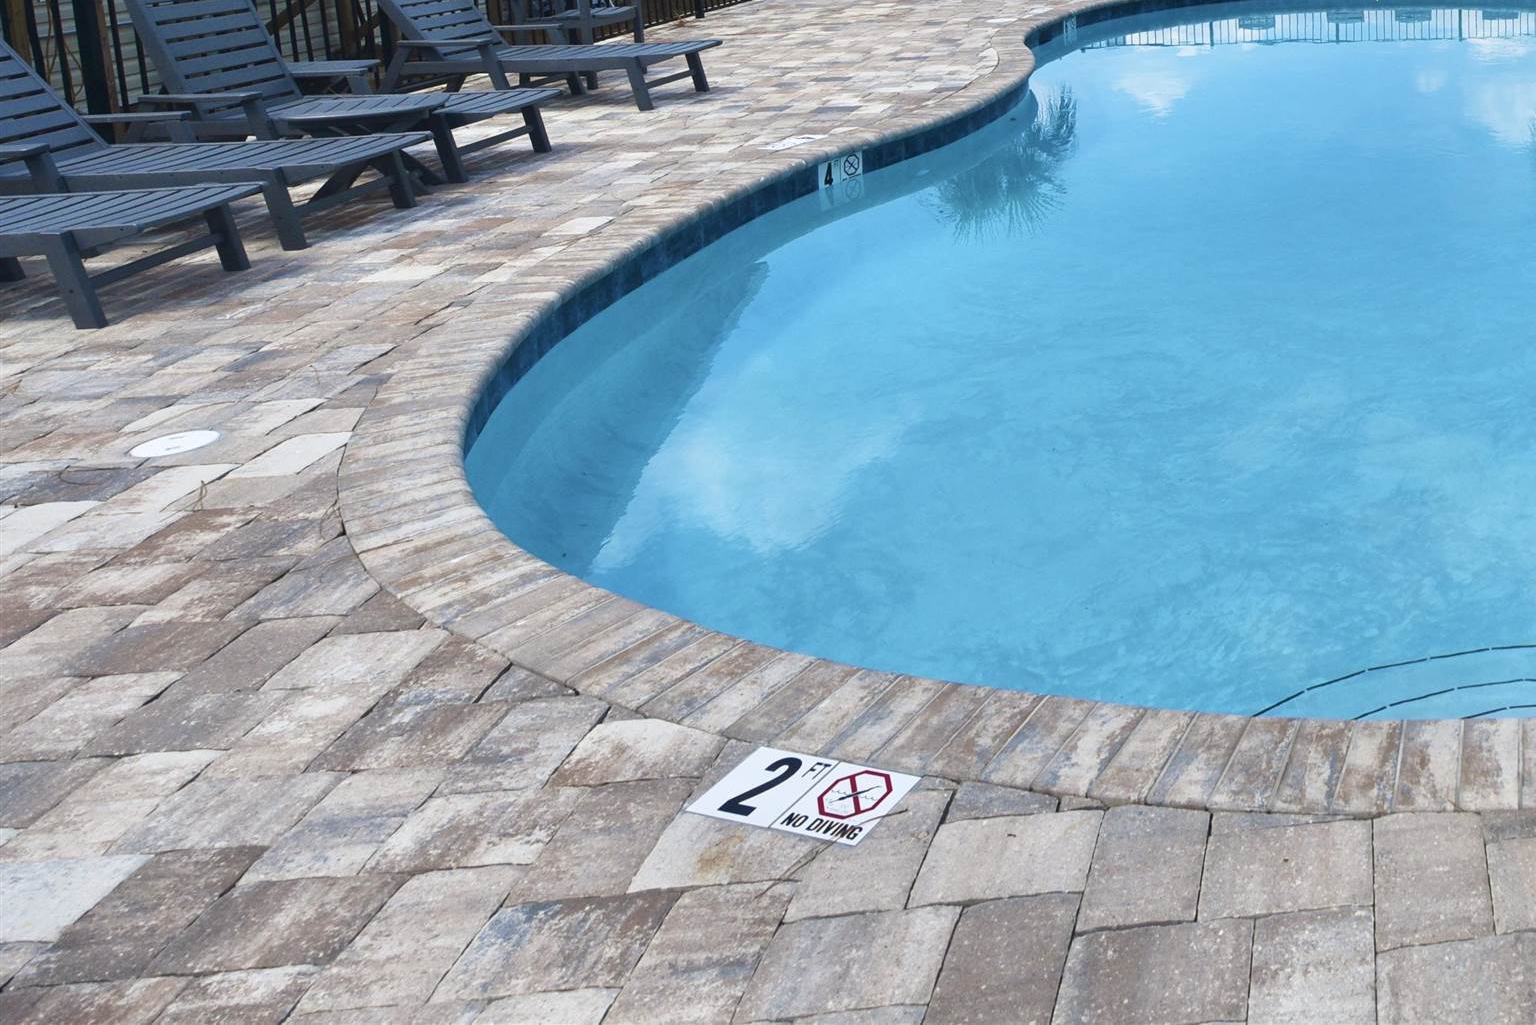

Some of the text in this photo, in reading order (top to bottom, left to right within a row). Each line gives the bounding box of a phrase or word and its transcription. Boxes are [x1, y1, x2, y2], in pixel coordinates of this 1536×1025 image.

[824, 162, 834, 185] 4
[717, 757, 832, 817] 2 FT
[780, 812, 863, 841] NO DIVING
